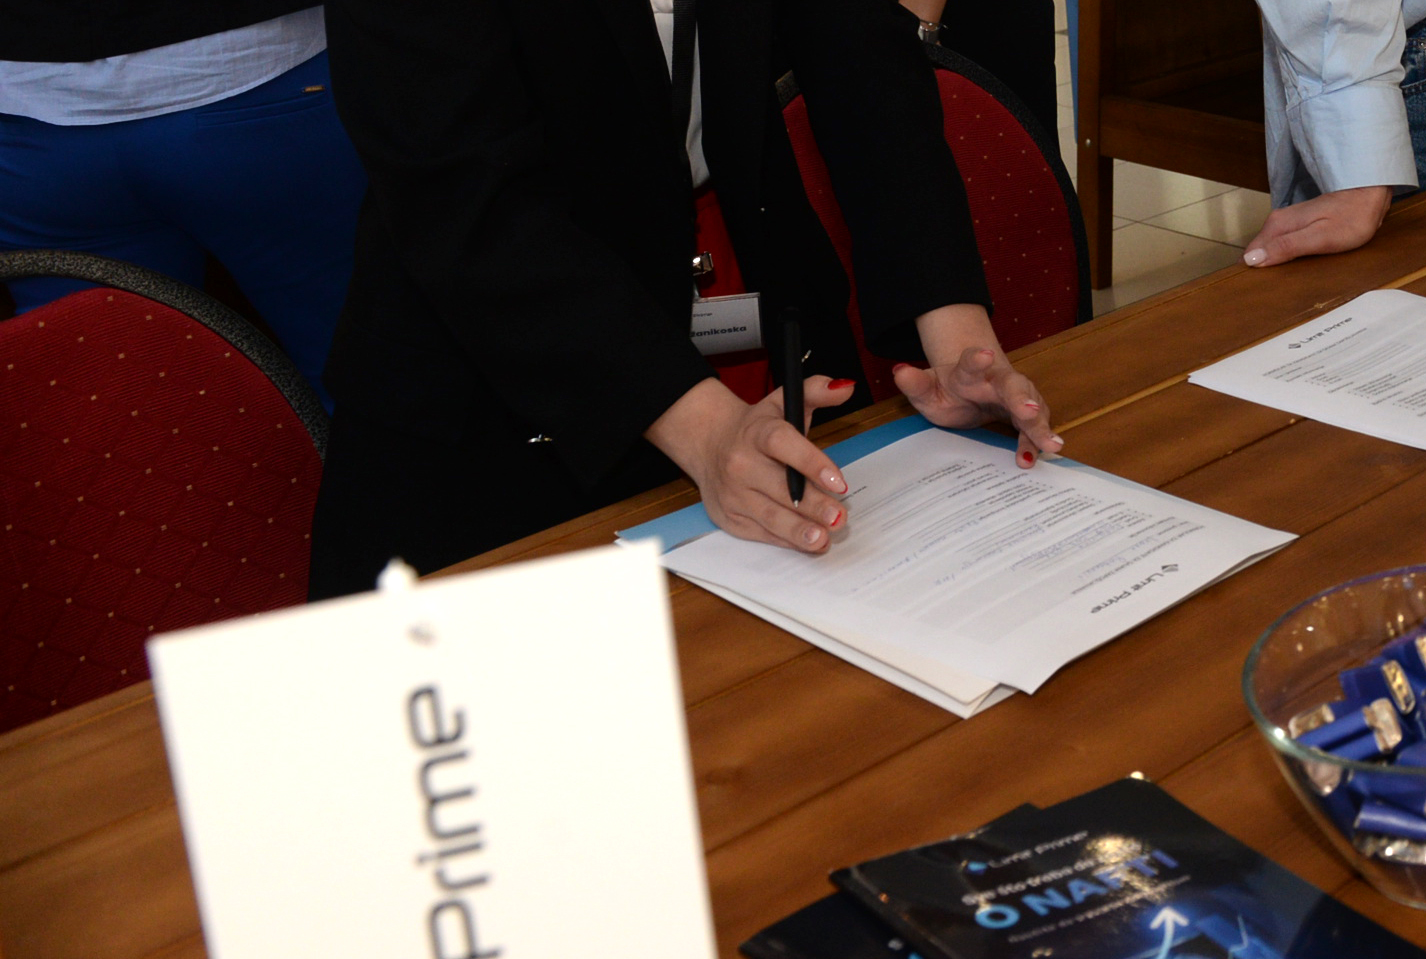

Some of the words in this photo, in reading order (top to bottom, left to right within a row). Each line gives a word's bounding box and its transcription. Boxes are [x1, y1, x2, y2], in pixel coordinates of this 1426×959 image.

[406, 683, 503, 959] Prime
[974, 904, 1020, 929] O
[1021, 849, 1179, 916] NAFTI
